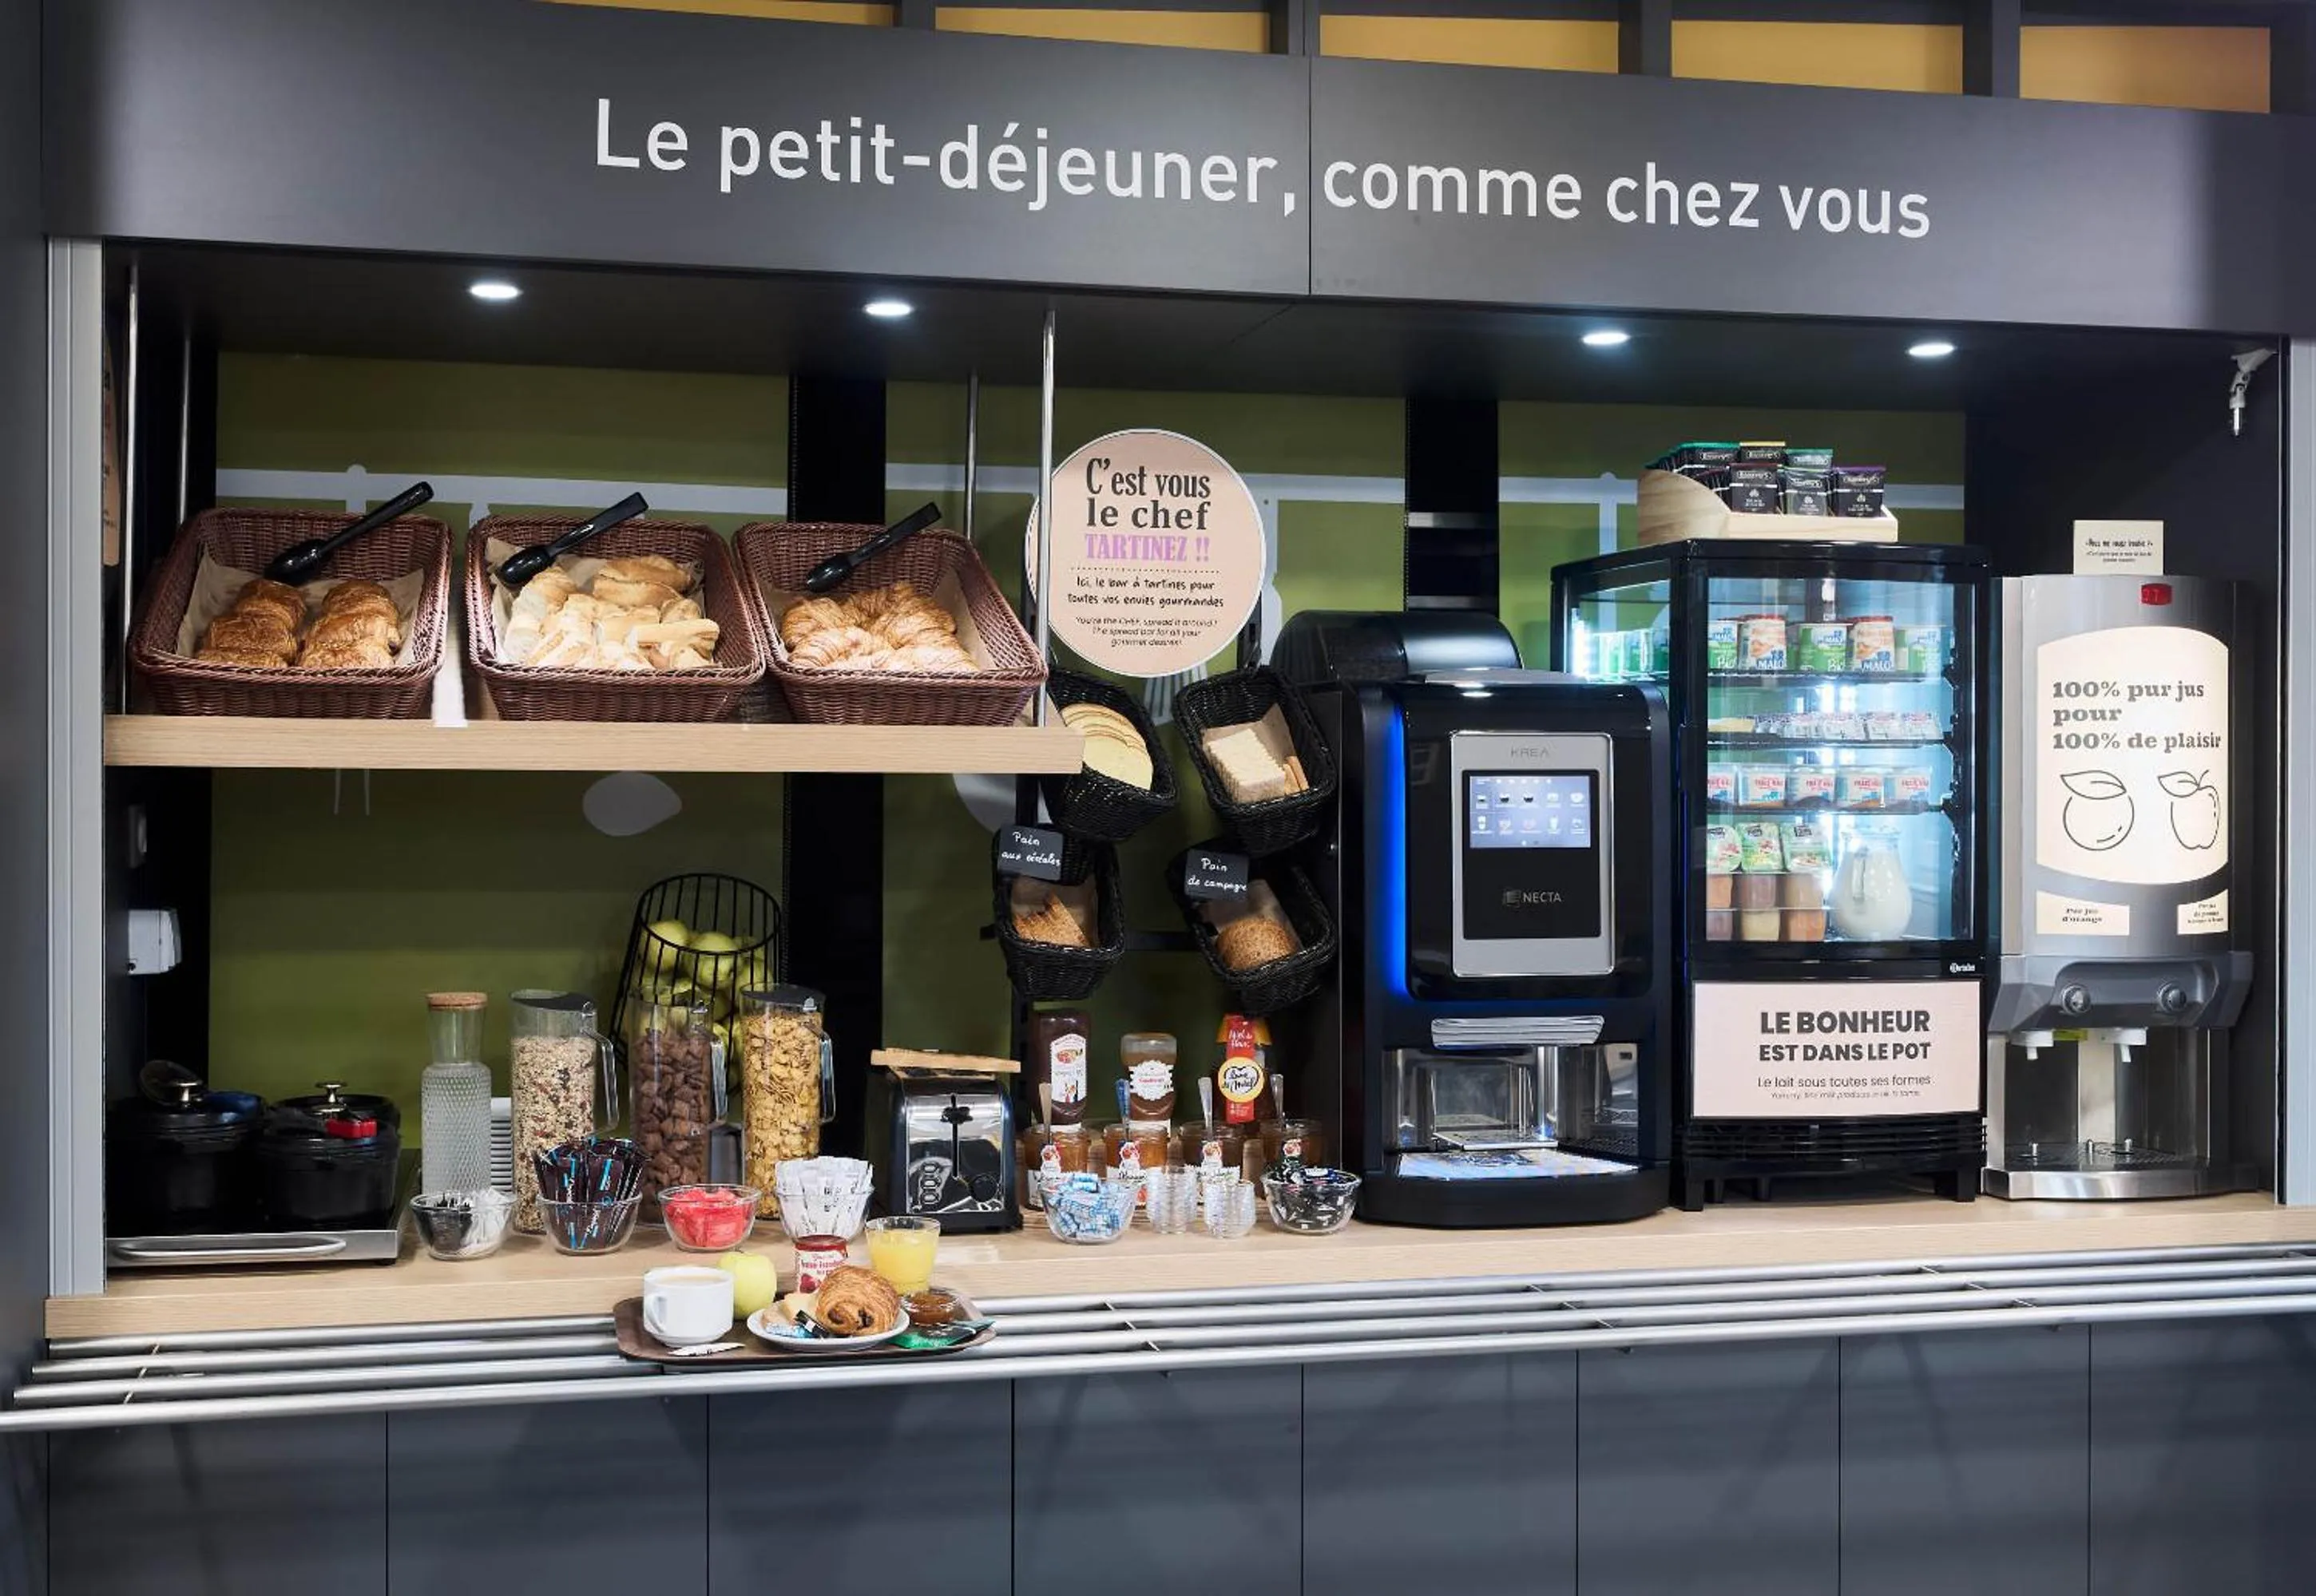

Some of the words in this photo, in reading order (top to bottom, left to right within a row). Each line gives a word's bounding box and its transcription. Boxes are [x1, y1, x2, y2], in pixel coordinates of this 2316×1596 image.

[597, 98, 688, 171] Le
[720, 117, 1295, 217] petit-déjeuner,
[1323, 160, 1582, 220] comme
[1606, 161, 1759, 228] chez
[1779, 185, 1930, 239] vous
[1086, 457, 1146, 496] C'est
[1155, 473, 1211, 499] vous
[1087, 497, 1119, 527] le
[1131, 499, 1211, 530] chef
[1085, 533, 1187, 562] TARTINEZ
[1196, 537, 1210, 562] !!
[1096, 577, 1105, 587] le
[1108, 577, 1128, 588] bar
[1144, 579, 1187, 590] tartines
[1190, 582, 1216, 592] pour
[1068, 593, 1099, 604] toutes
[1103, 595, 1120, 604] vos
[1124, 595, 1155, 605] envies
[1159, 596, 1223, 608] gourmandes
[2052, 681, 2120, 699] 100%
[2127, 684, 2171, 703] pur
[2175, 680, 2204, 703] jus
[2052, 708, 2122, 727] pour
[2052, 732, 2120, 750] 100%
[2127, 732, 2158, 749] de
[2164, 731, 2222, 754] plaisir
[1510, 747, 1549, 758] KREA
[1012, 831, 1040, 846] Pain
[1200, 857, 1227, 872] Pain
[1188, 875, 1200, 885] de
[1523, 891, 1562, 903] NECTA
[1760, 1012, 1791, 1035] LE
[1796, 1010, 1930, 1034] BONHEUR
[1759, 1044, 1798, 1062] EST
[1802, 1044, 1863, 1061] DANS
[1867, 1043, 1889, 1061] LE
[1892, 1041, 1932, 1060] POT
[1758, 1077, 1772, 1087] Le
[1775, 1076, 1795, 1087] lait
[1798, 1078, 1826, 1087] sous
[1829, 1077, 1868, 1087] toutes
[1870, 1077, 1890, 1086] ses
